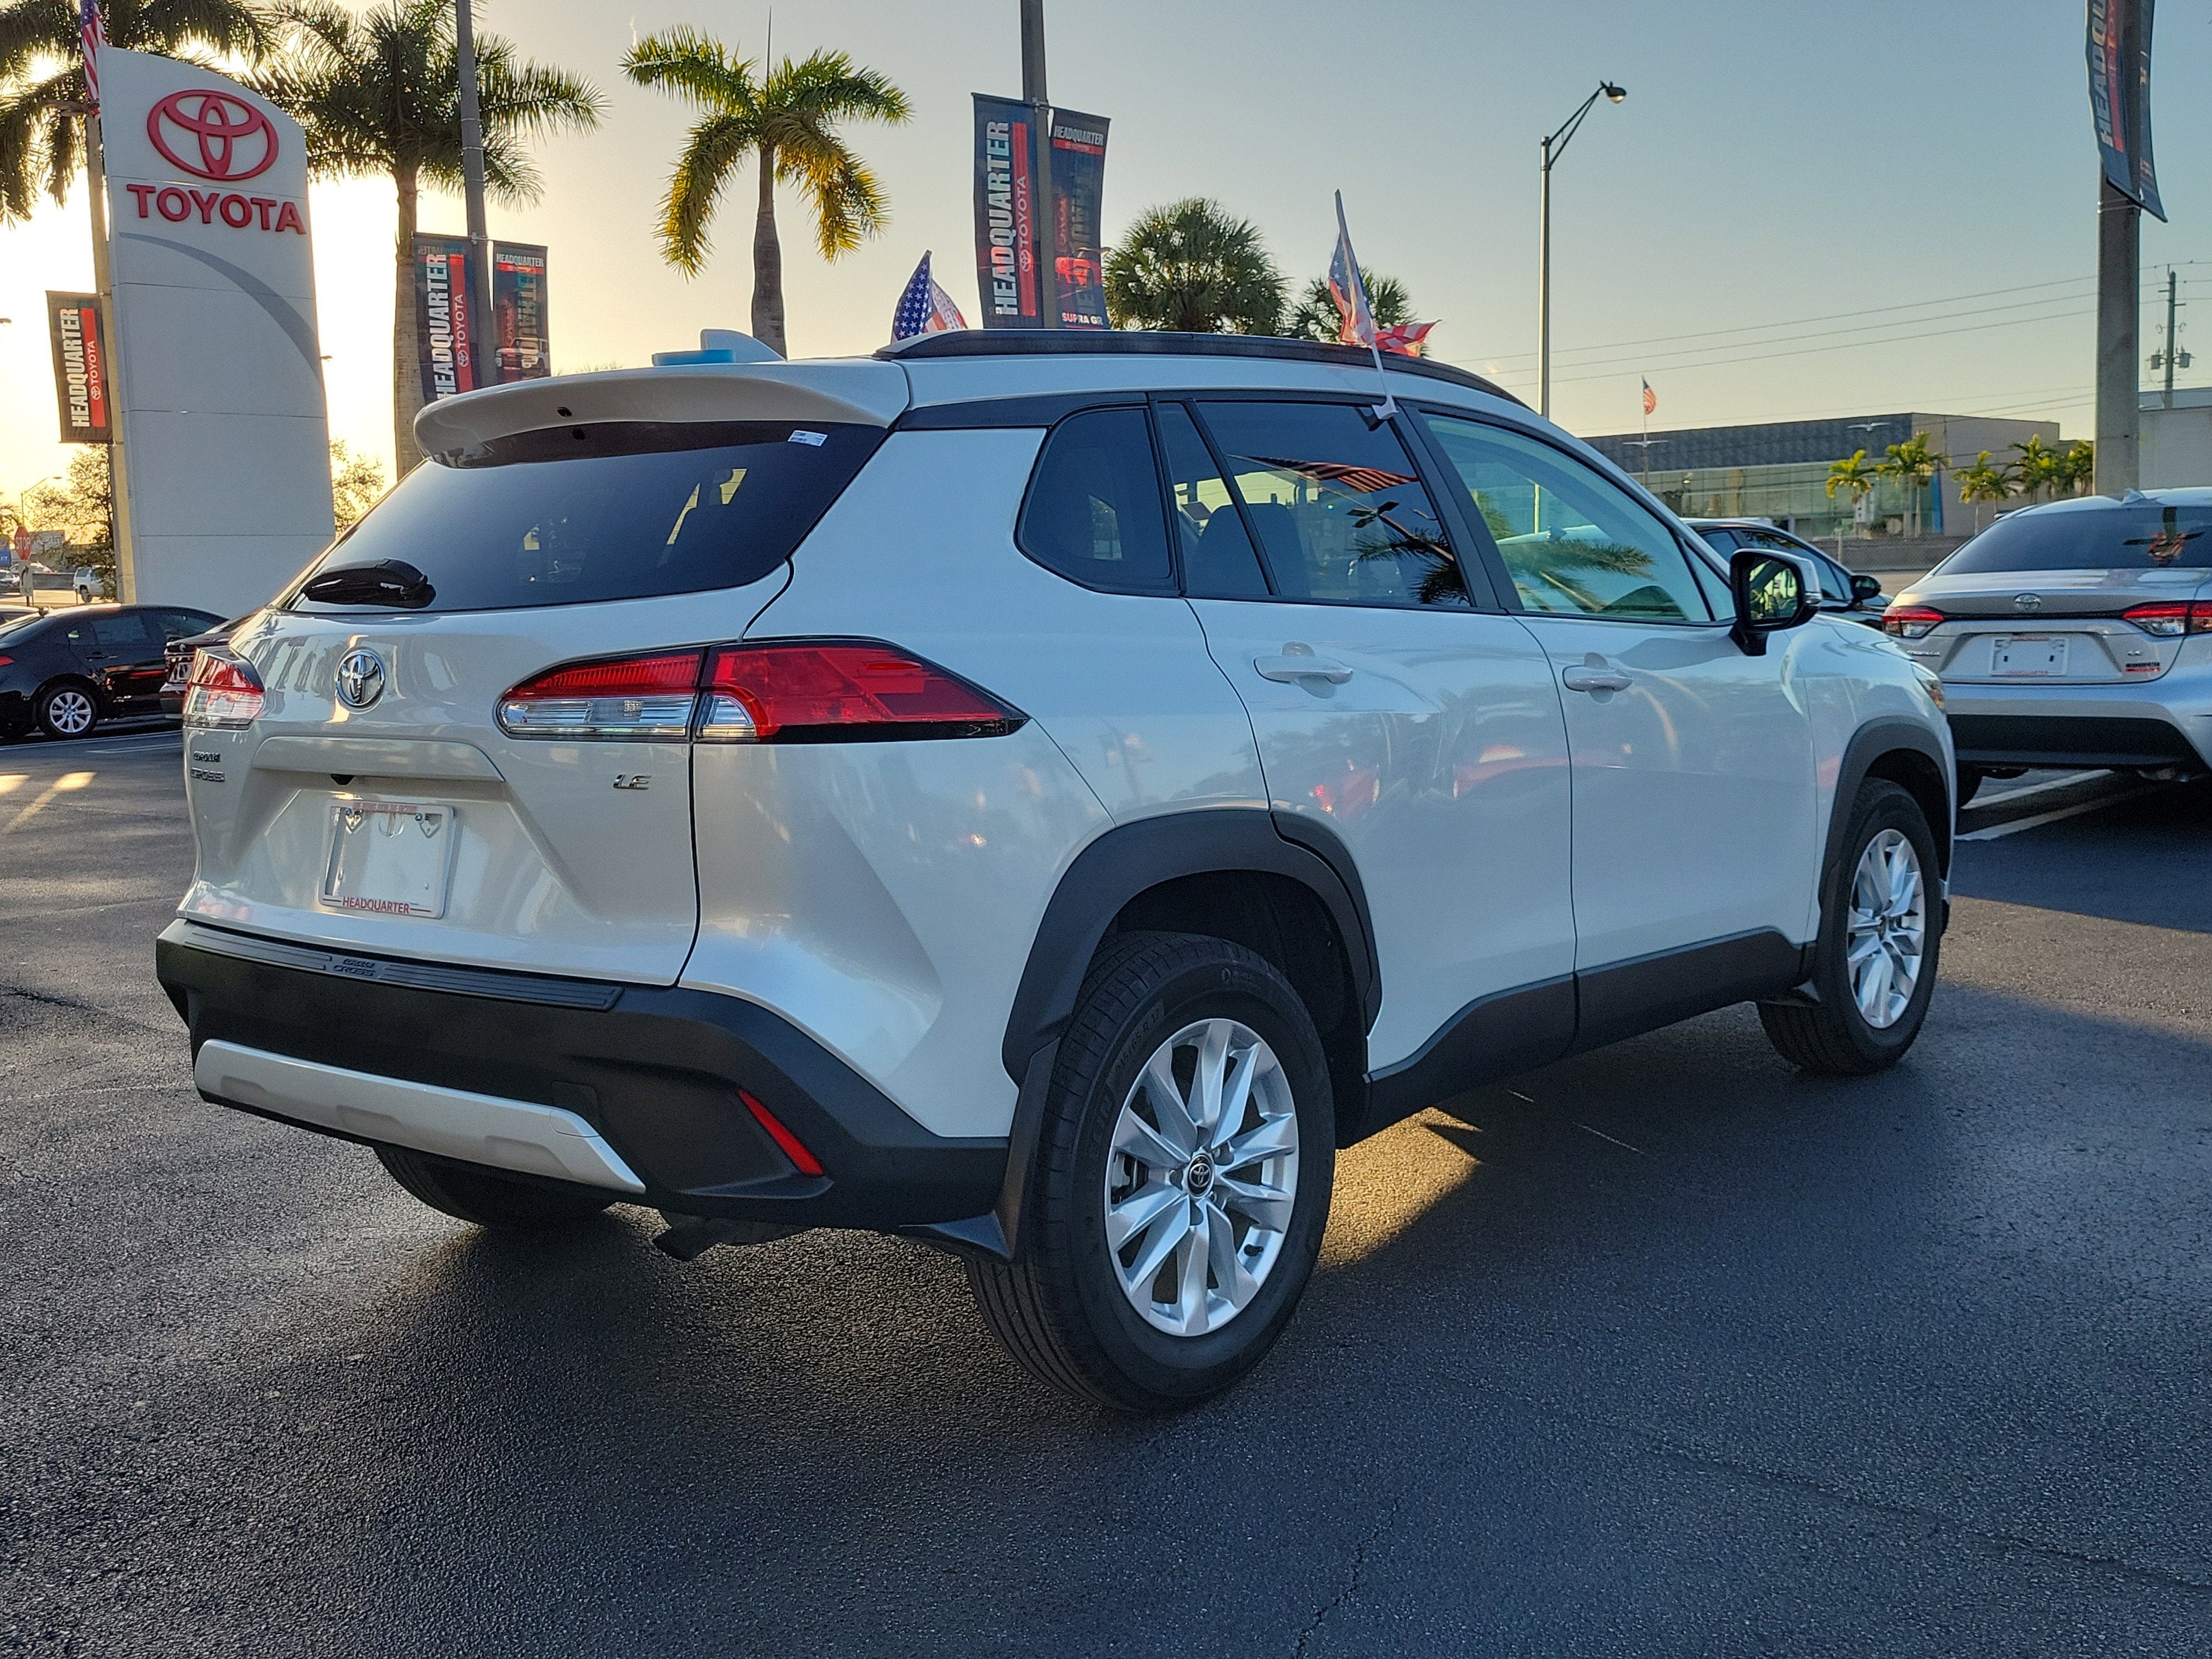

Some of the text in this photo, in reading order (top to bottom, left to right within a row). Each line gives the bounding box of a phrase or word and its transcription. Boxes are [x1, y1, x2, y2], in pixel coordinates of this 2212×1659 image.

[1053, 125, 1104, 146] HEADQUARTER
[127, 184, 306, 235] TOYOTA
[986, 121, 1019, 315] HEADQUARTER
[1016, 176, 1029, 247] TOYOTA
[496, 253, 544, 268] HEADQUARTER
[426, 253, 458, 399] HEADQUARTER
[455, 294, 466, 348] TOYOTA
[1062, 312, 1104, 325] SUPRA GR
[60, 308, 91, 427] HEADQUARTER
[87, 340, 99, 385] TOYOTA
[15, 536, 31, 550] STOP
[190, 767, 225, 783] CROSS
[613, 774, 652, 791] LE
[342, 896, 410, 914] HEADQUARTER
[332, 964, 375, 977] CROSS
